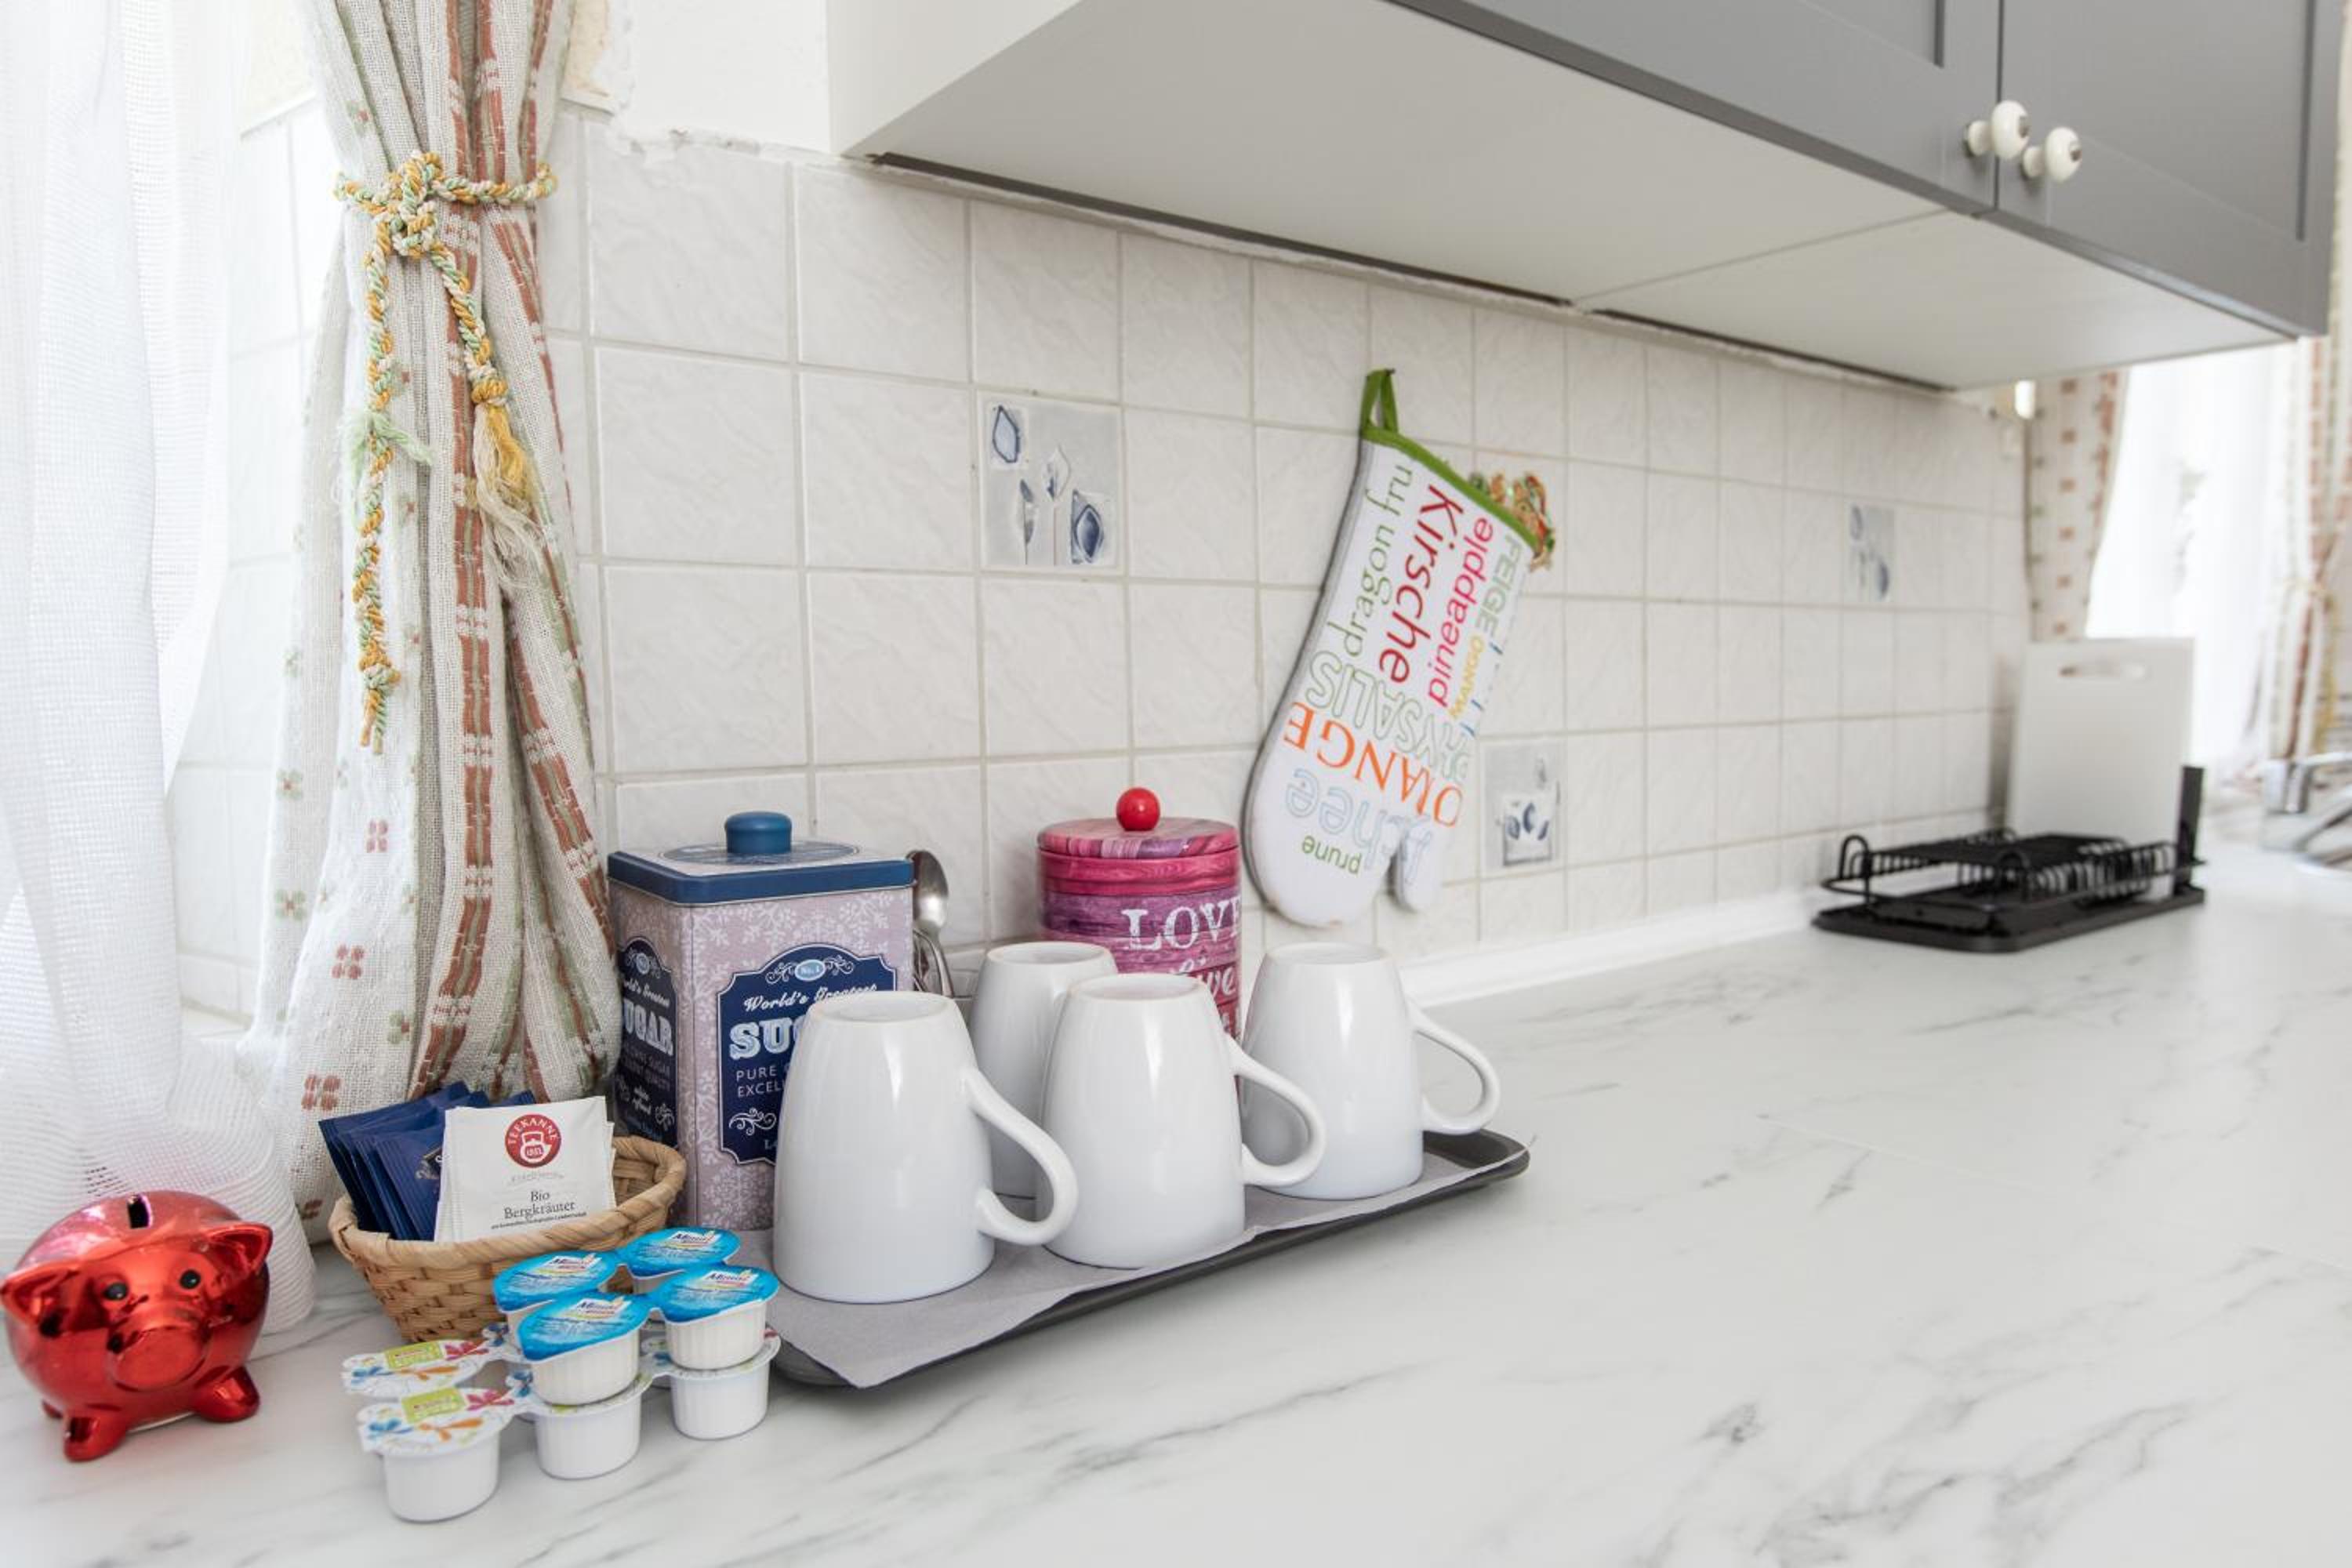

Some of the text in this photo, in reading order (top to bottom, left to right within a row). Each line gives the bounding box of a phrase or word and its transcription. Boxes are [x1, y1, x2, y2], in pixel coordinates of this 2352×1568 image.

[1327, 524, 1395, 657] dragon
[1379, 484, 1465, 684] Kirsche
[1475, 535, 1523, 638] FEIGE
[1428, 517, 1494, 707] pineapple
[1301, 835, 1363, 875] prune
[623, 997, 674, 1057] UGAR
[744, 991, 810, 1013] World's
[736, 1065, 778, 1082] PURE
[504, 1201, 575, 1221] Bergkräuter
[530, 1190, 550, 1203] Bio
